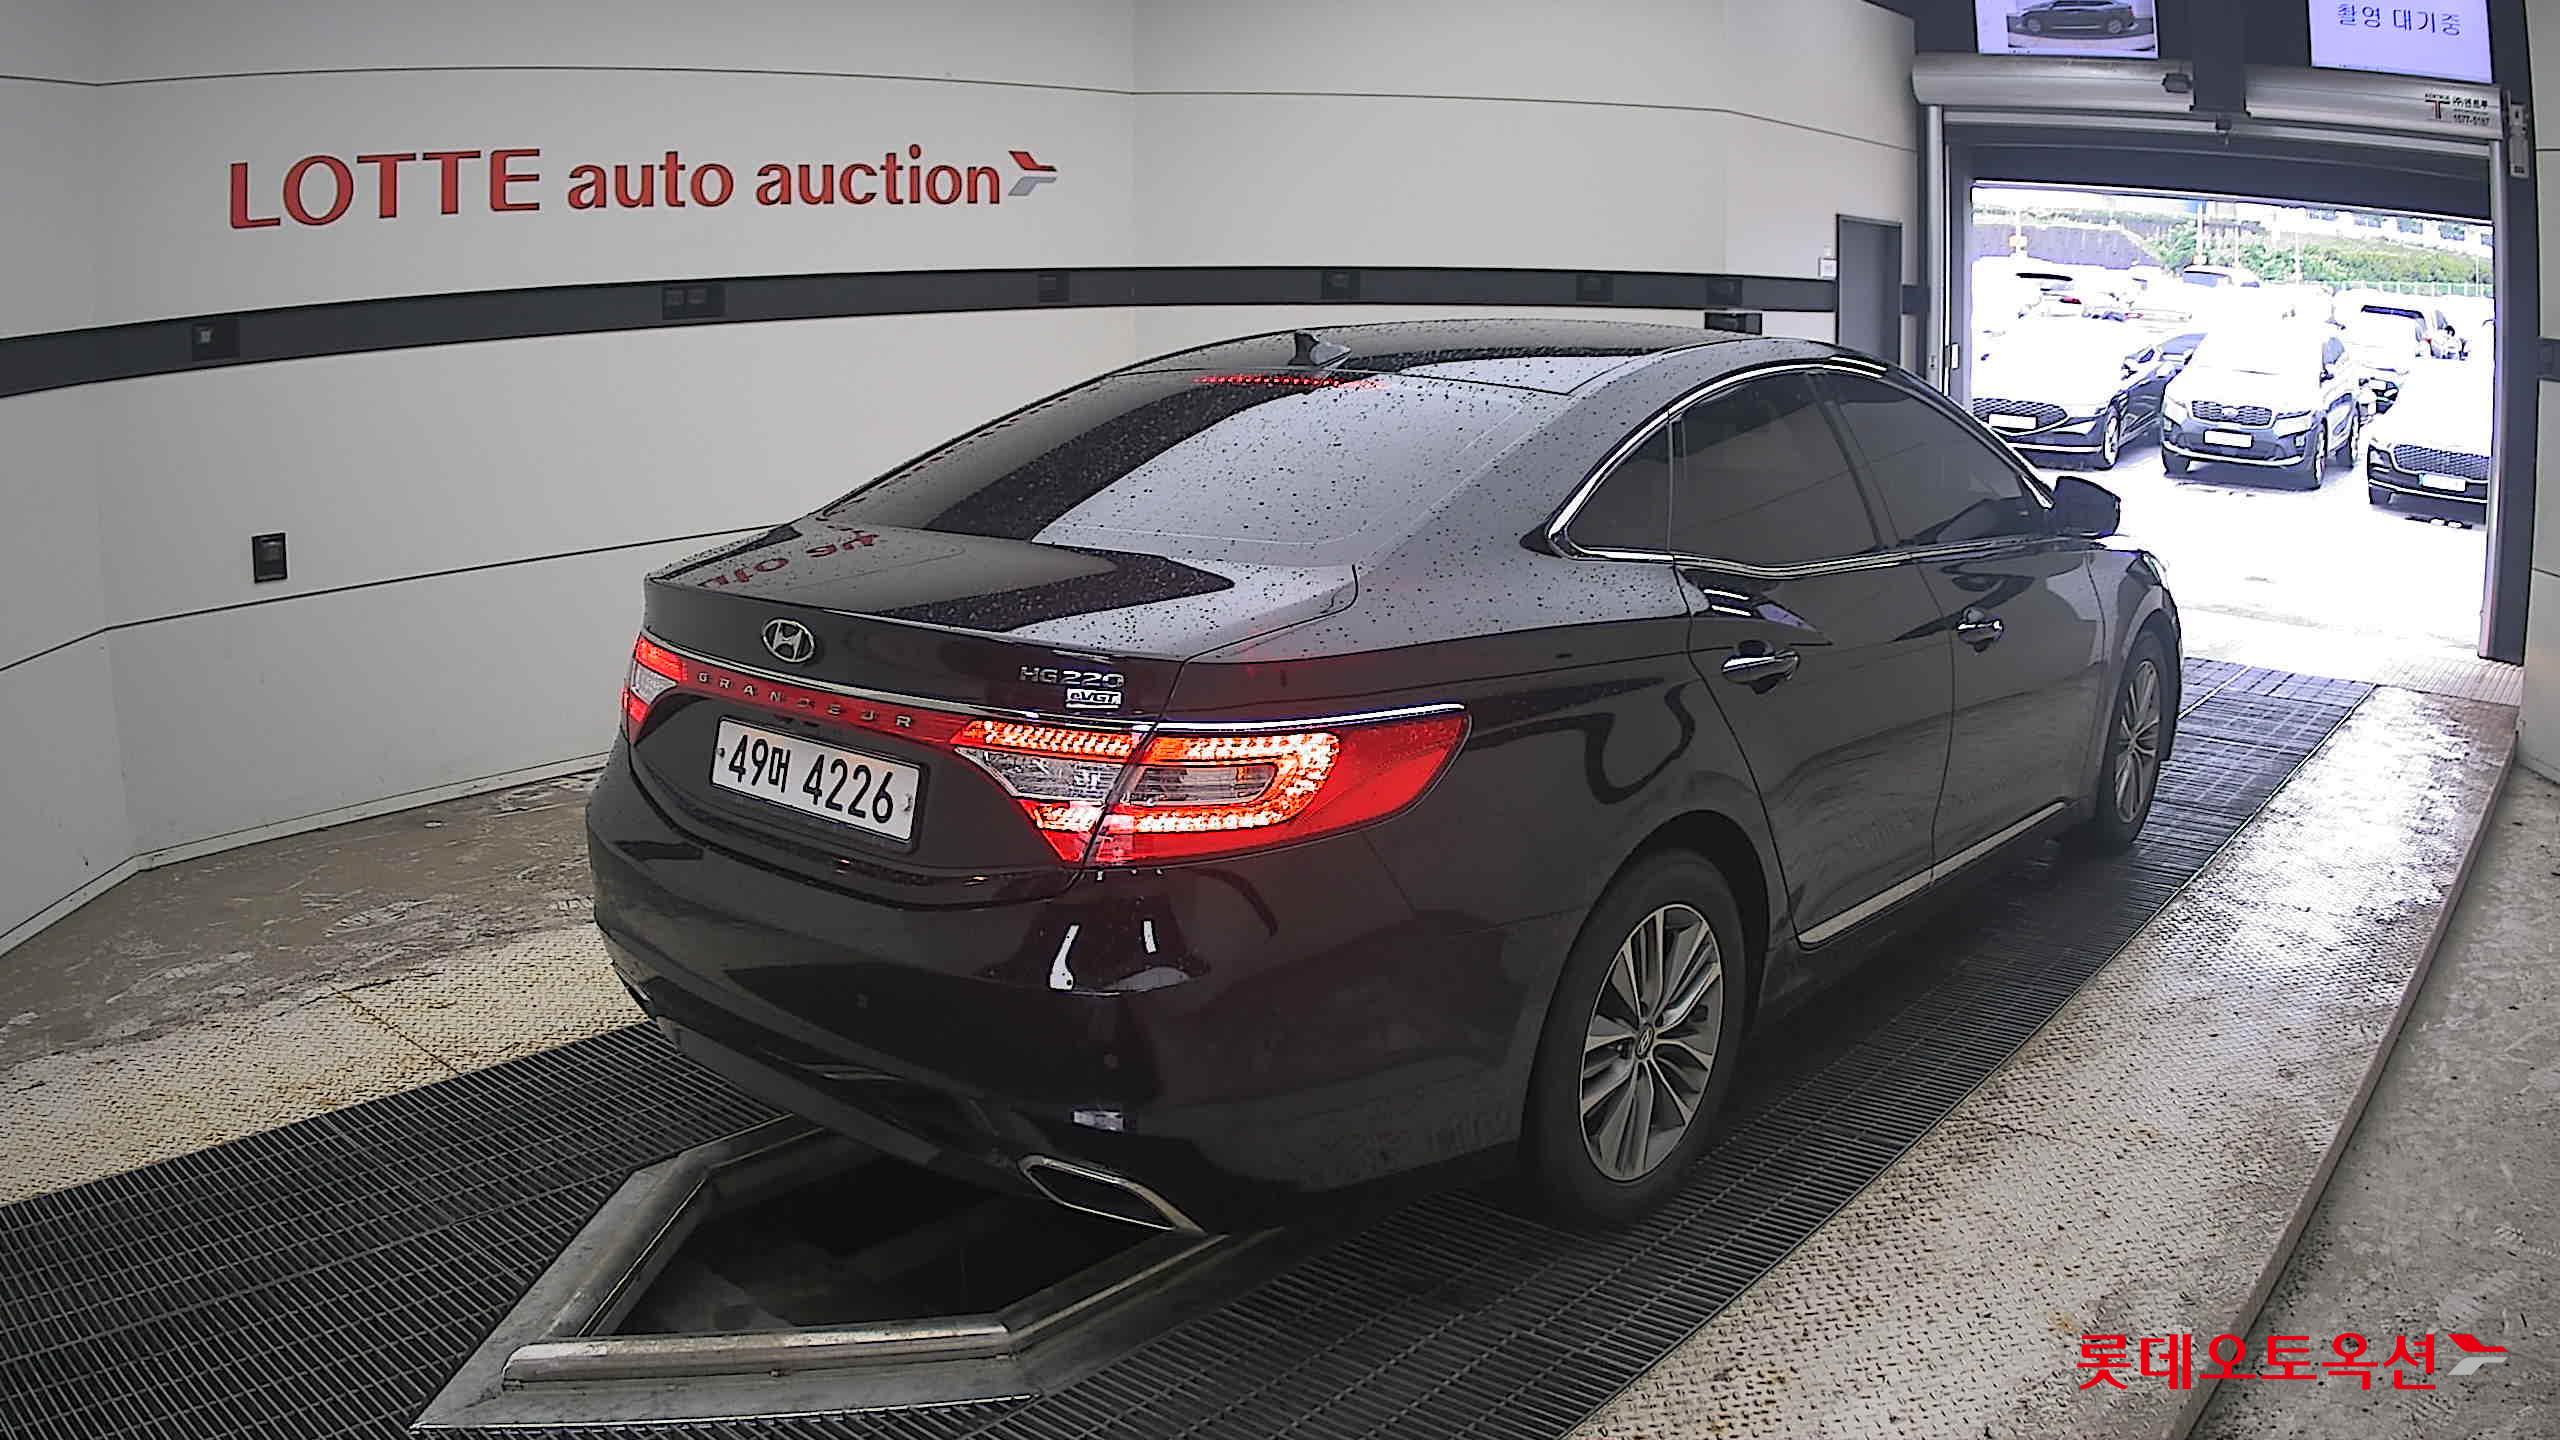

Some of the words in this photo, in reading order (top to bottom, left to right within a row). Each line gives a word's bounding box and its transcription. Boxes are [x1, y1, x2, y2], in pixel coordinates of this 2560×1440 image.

[2338, 4, 2381, 28] 촬영
[2393, 9, 2460, 36] 대기중
[229, 148, 541, 229] LOTTE
[567, 151, 735, 209] auto
[755, 143, 1004, 207] auction
[698, 671, 913, 728] GRANDEUR
[728, 734, 791, 793] 49머
[802, 754, 894, 825] 4226
